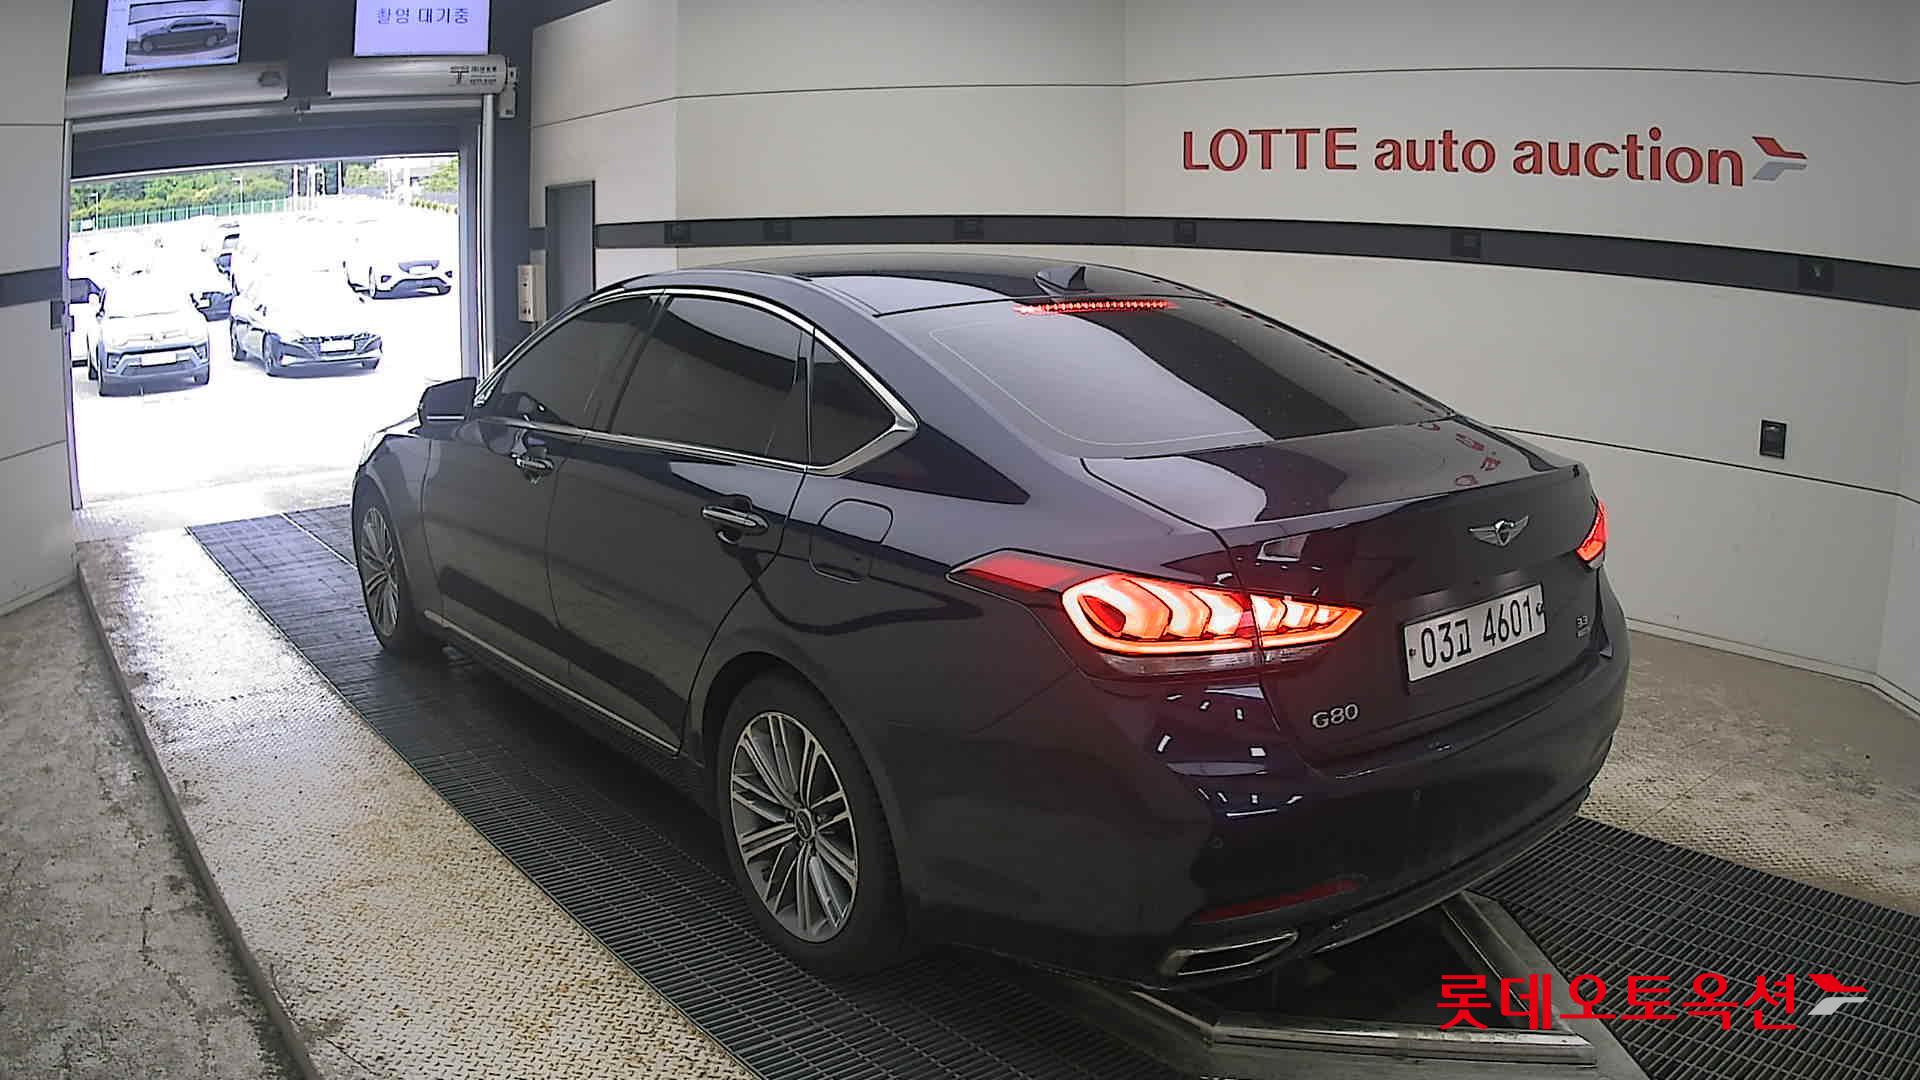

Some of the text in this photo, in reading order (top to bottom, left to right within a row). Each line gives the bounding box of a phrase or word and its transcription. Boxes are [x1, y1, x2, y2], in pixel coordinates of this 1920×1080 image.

[418, 7, 469, 24] 대기중
[1183, 127, 1744, 187] LOTTE auto auction
[1421, 595, 1533, 668] 03고 4601
[1311, 703, 1359, 729] G80
